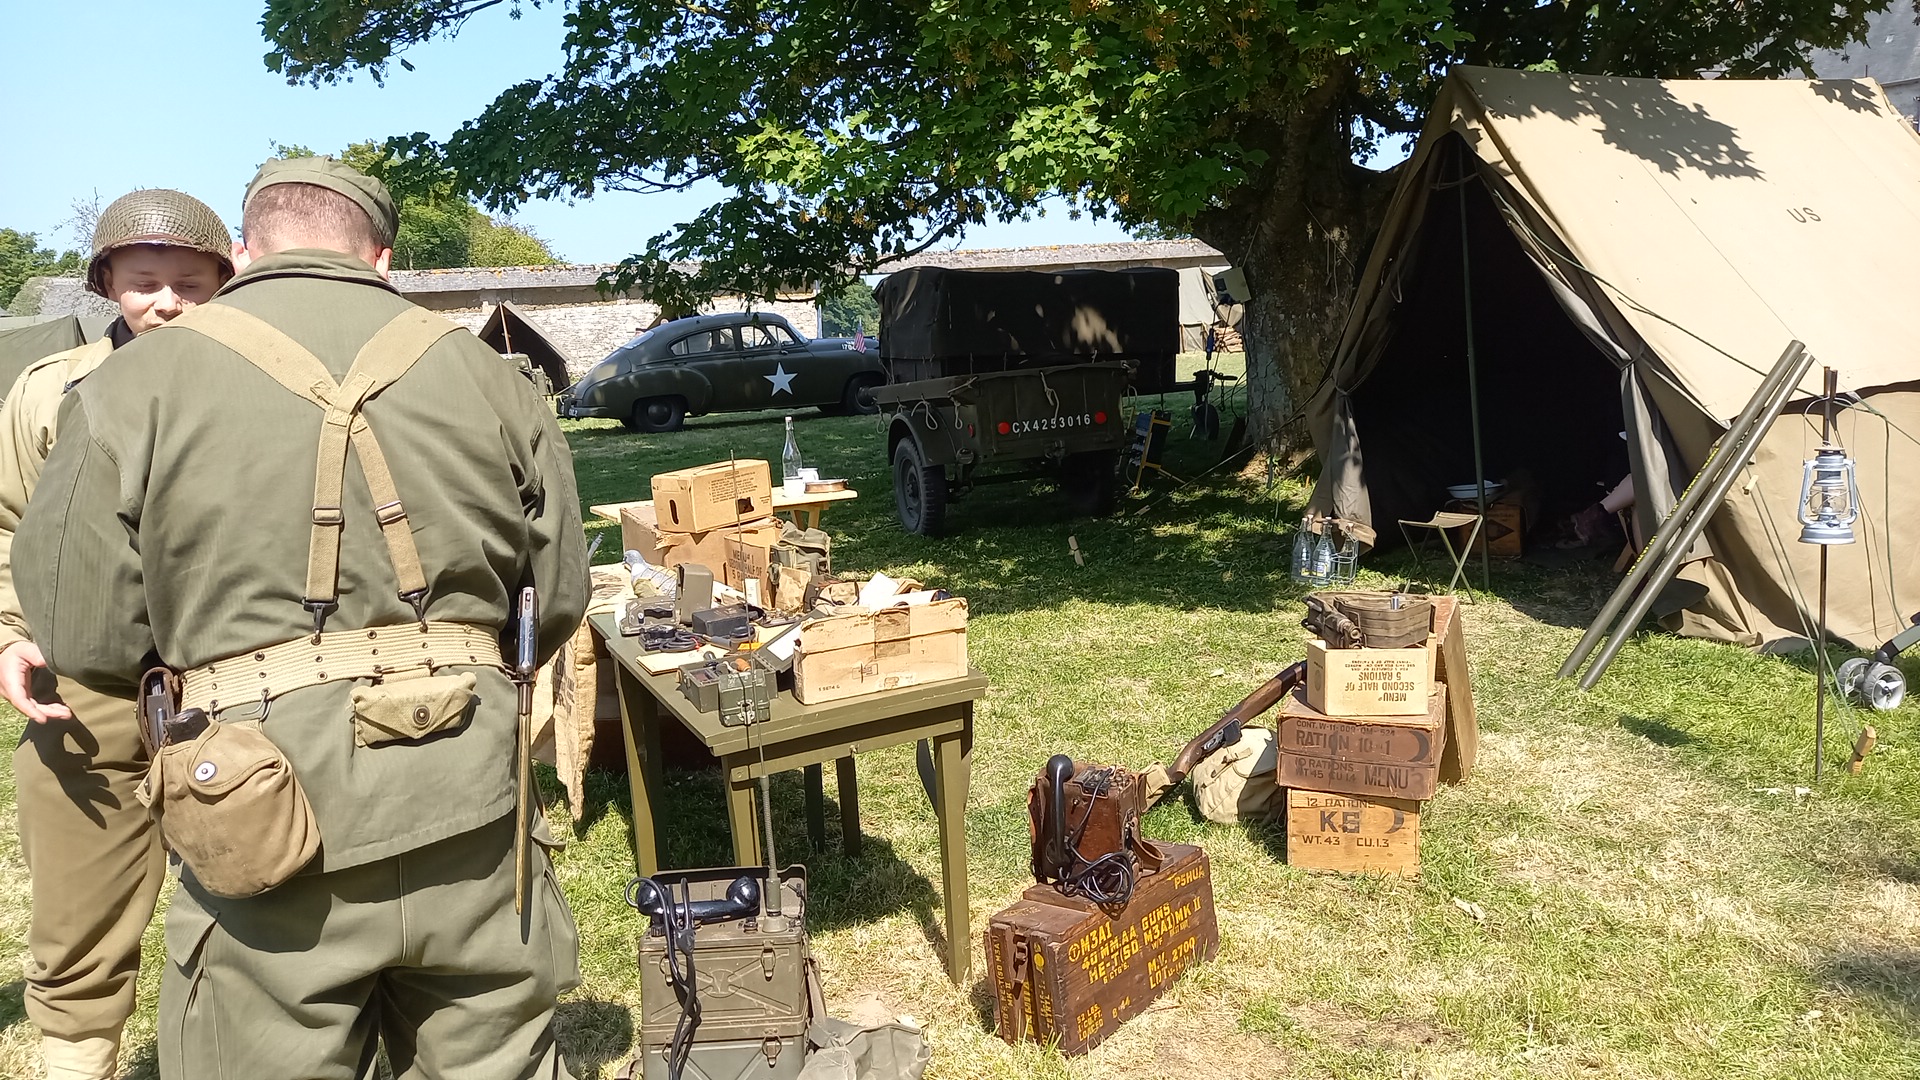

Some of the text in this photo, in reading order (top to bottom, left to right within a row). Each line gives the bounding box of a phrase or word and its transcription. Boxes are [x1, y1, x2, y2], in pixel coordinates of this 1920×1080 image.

[1786, 207, 1821, 223] US
[1012, 413, 1091, 434] CX4253016
[1345, 682, 1414, 691] SECOND HALF OF
[1358, 672, 1401, 680] 5 RATIONS
[1296, 730, 1349, 751] RATION
[1309, 759, 1354, 771] RATIONS
[1364, 765, 1408, 789] MENU
[1306, 797, 1375, 809] 12 RATIONS
[1141, 902, 1171, 931] GUNS
[1080, 921, 1112, 955] M3A1
[1171, 937, 1195, 962] 2700
